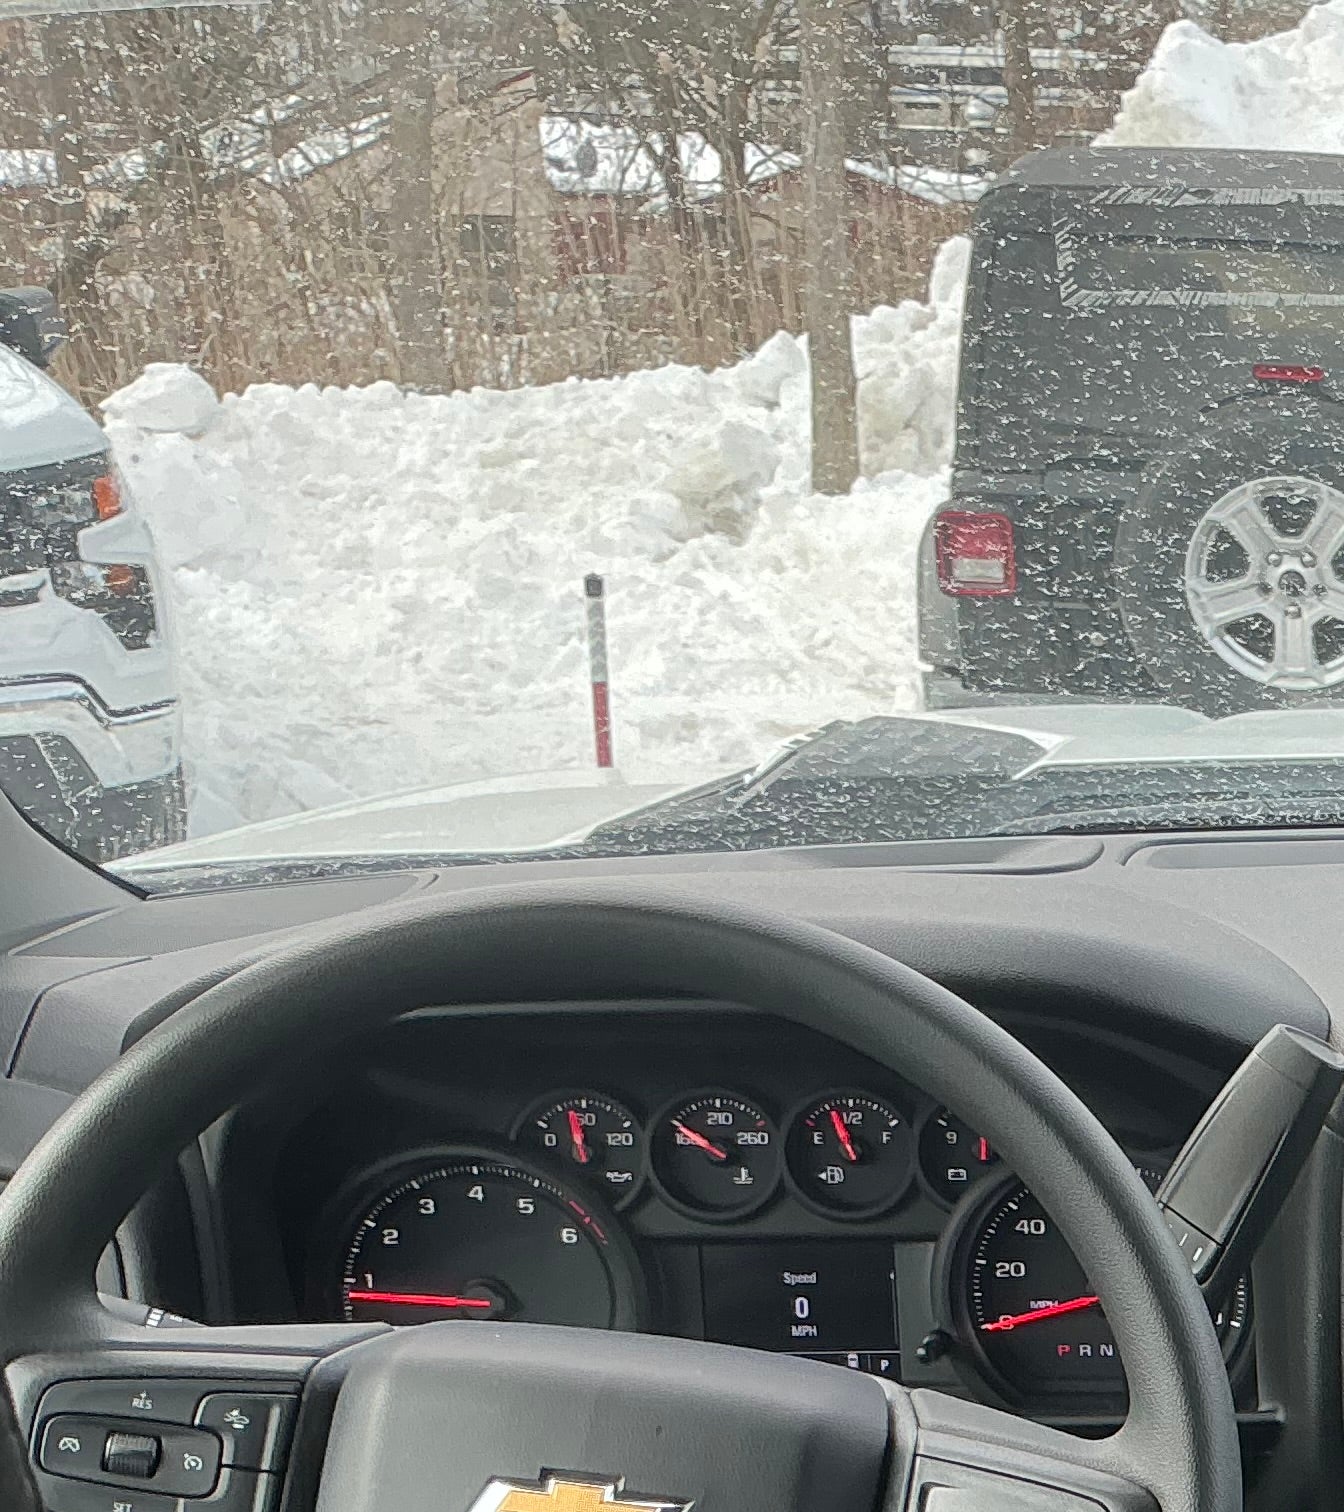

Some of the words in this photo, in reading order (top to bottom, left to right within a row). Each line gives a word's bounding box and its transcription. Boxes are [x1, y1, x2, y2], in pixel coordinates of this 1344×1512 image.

[706, 1112, 733, 1126] 210
[544, 1133, 556, 1146] 0
[606, 1132, 633, 1146] 120
[736, 1132, 769, 1146] 260
[812, 1132, 824, 1145] E
[882, 1132, 892, 1144] F
[946, 1131, 958, 1144] 9
[468, 1184, 484, 1202] 4
[418, 1198, 436, 1215] 3
[517, 1198, 534, 1215] 5
[1014, 1218, 1046, 1235] 40
[382, 1228, 400, 1245] 2
[560, 1227, 578, 1244] 6
[995, 1262, 1026, 1278] 20
[364, 1272, 374, 1288] 1
[783, 1271, 817, 1286] Speed
[794, 1296, 810, 1319] 0
[791, 1325, 818, 1337] MPH
[1057, 1344, 1071, 1356] P
[1079, 1344, 1092, 1356] R
[1100, 1344, 1114, 1356] N
